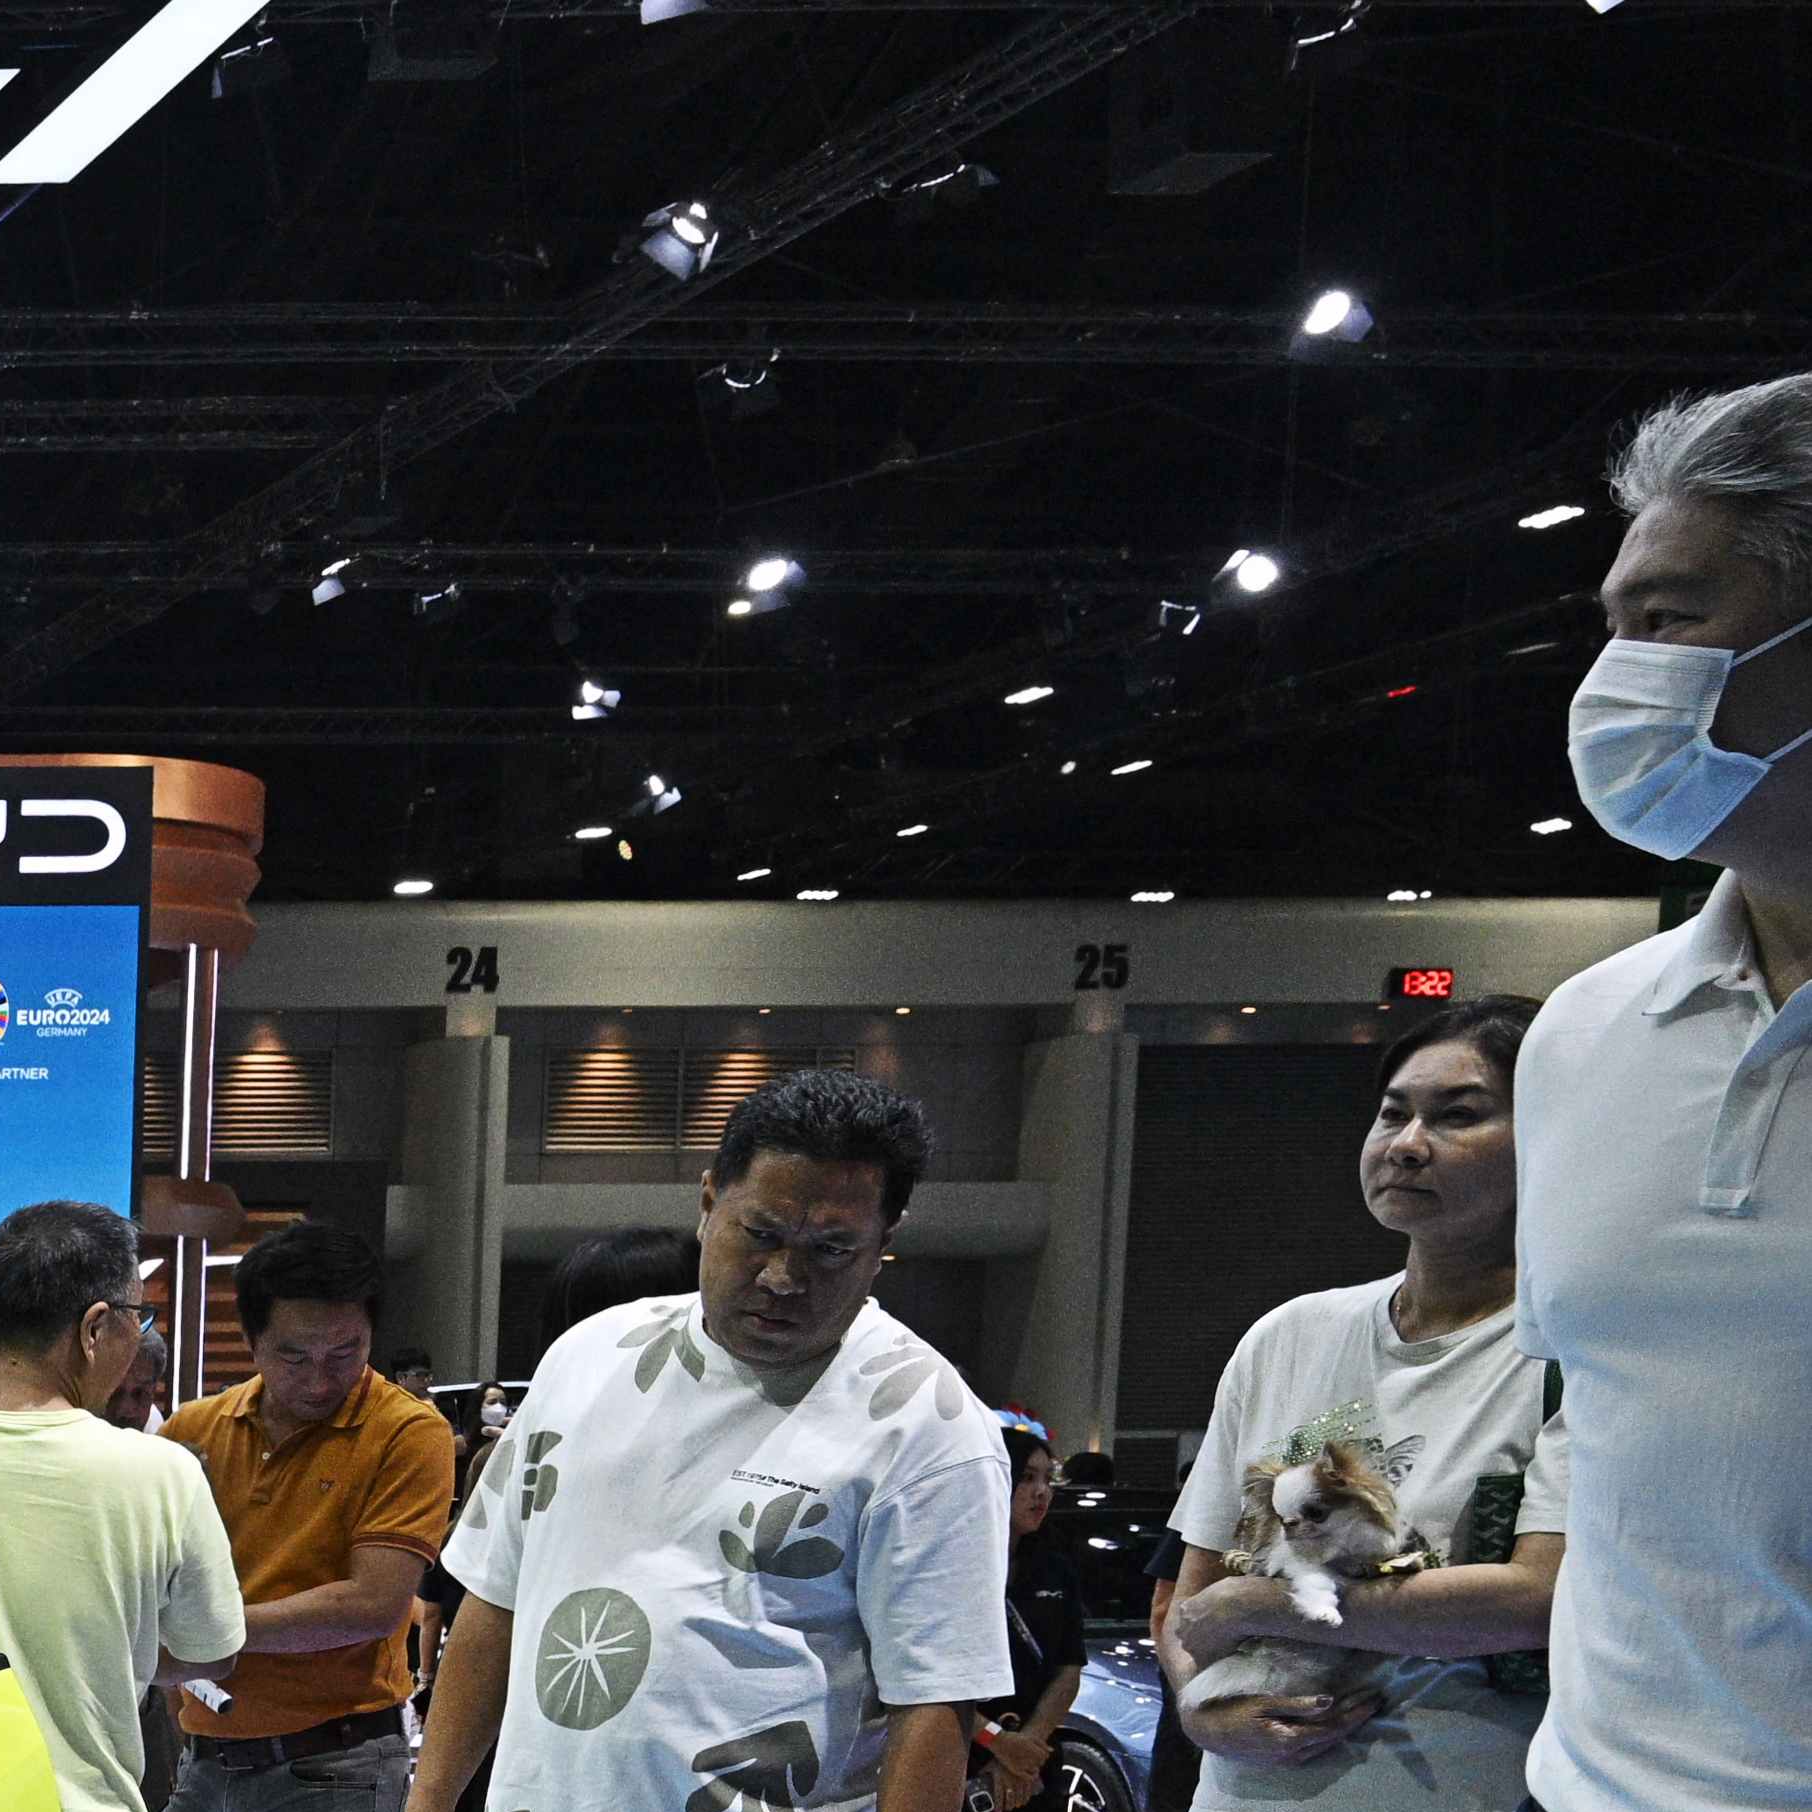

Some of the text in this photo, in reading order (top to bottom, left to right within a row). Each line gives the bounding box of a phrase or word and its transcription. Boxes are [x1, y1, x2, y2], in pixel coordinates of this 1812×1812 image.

[445, 946, 499, 993] 24
[1076, 944, 1129, 990] 25
[46, 992, 80, 1006] UEFA
[16, 1009, 111, 1026] EURO2024
[36, 1028, 88, 1037] GERMANY
